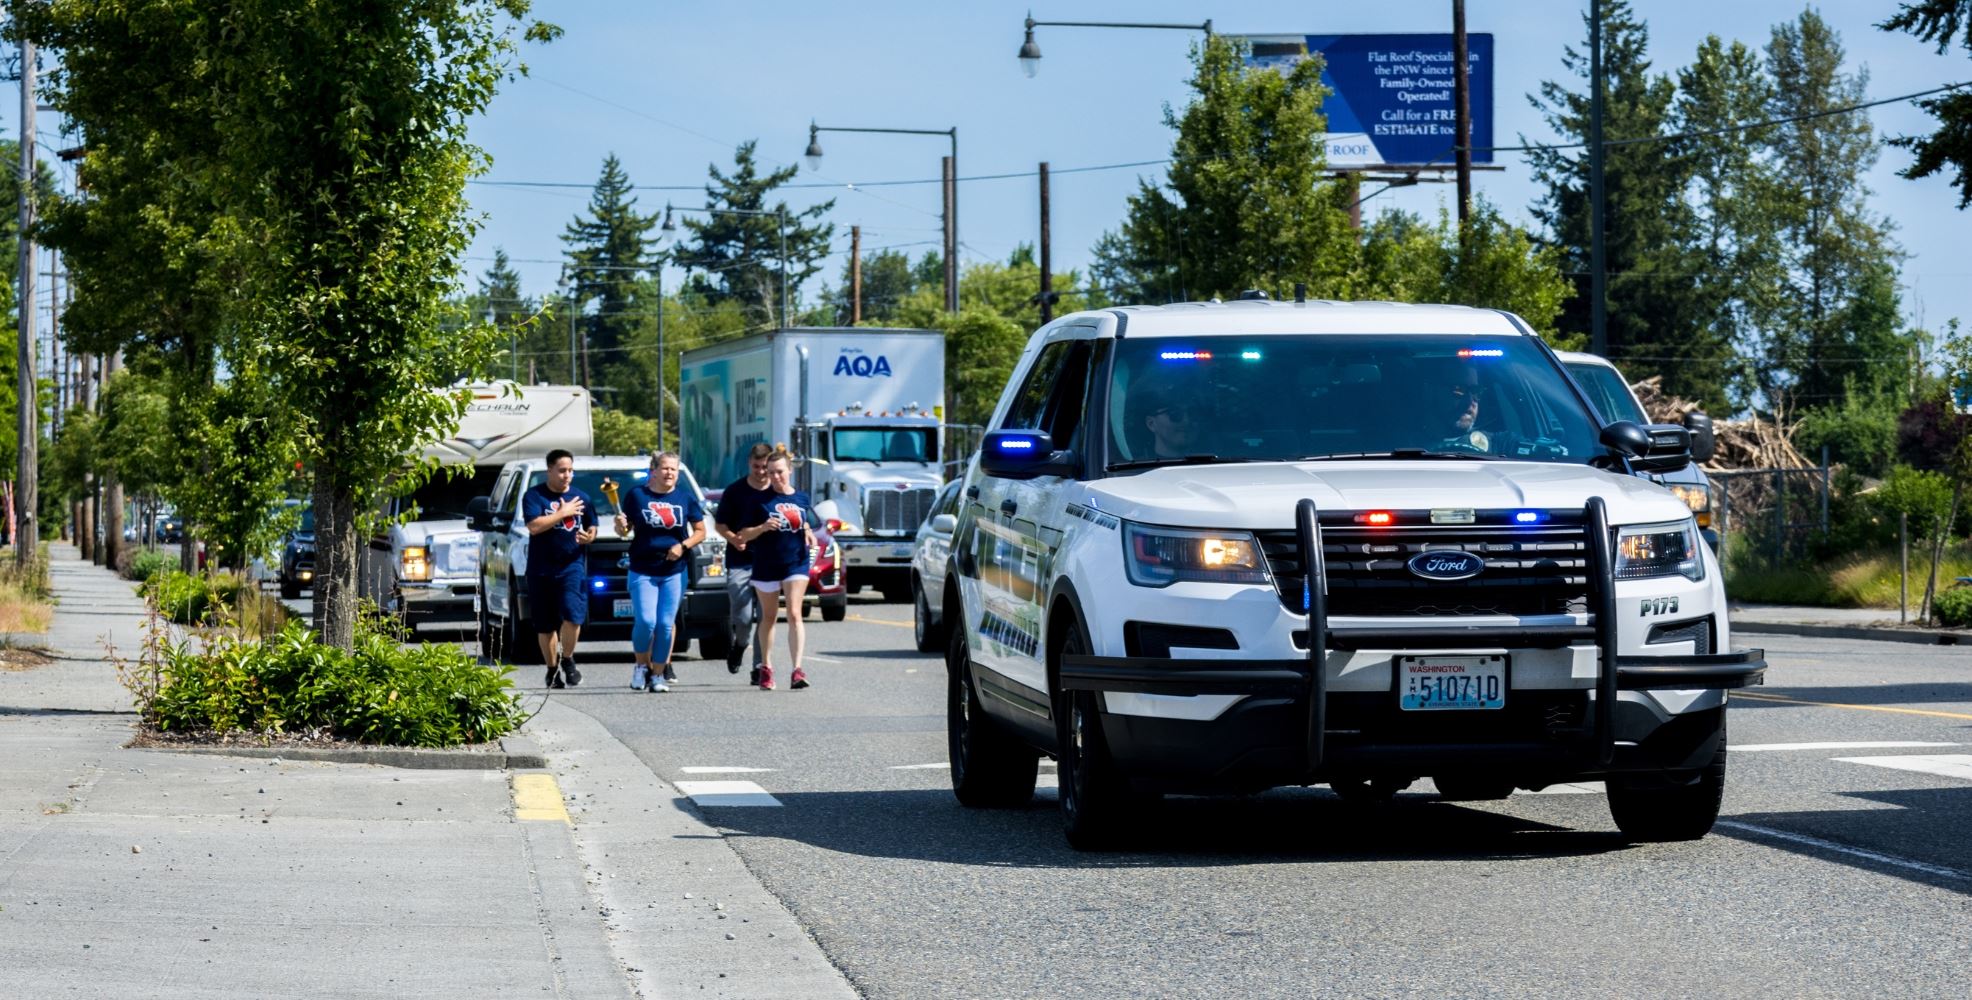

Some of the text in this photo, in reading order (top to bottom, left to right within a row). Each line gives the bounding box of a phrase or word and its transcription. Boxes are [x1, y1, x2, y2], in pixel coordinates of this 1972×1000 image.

[1368, 51, 1479, 64] Flat Roof Speciali in
[1374, 65, 1391, 75] the
[1393, 65, 1420, 75] PNW
[1422, 64, 1448, 74] since
[1380, 78, 1456, 90] Family-Owned
[1397, 90, 1450, 104] Operated!
[1381, 109, 1456, 121] Call for a FRE
[1374, 124, 1439, 135] ESTIMATE
[833, 355, 892, 378] AQA
[1426, 558, 1467, 571] Ford
[1640, 596, 1679, 617] P173
[1420, 675, 1499, 702] 51071D
